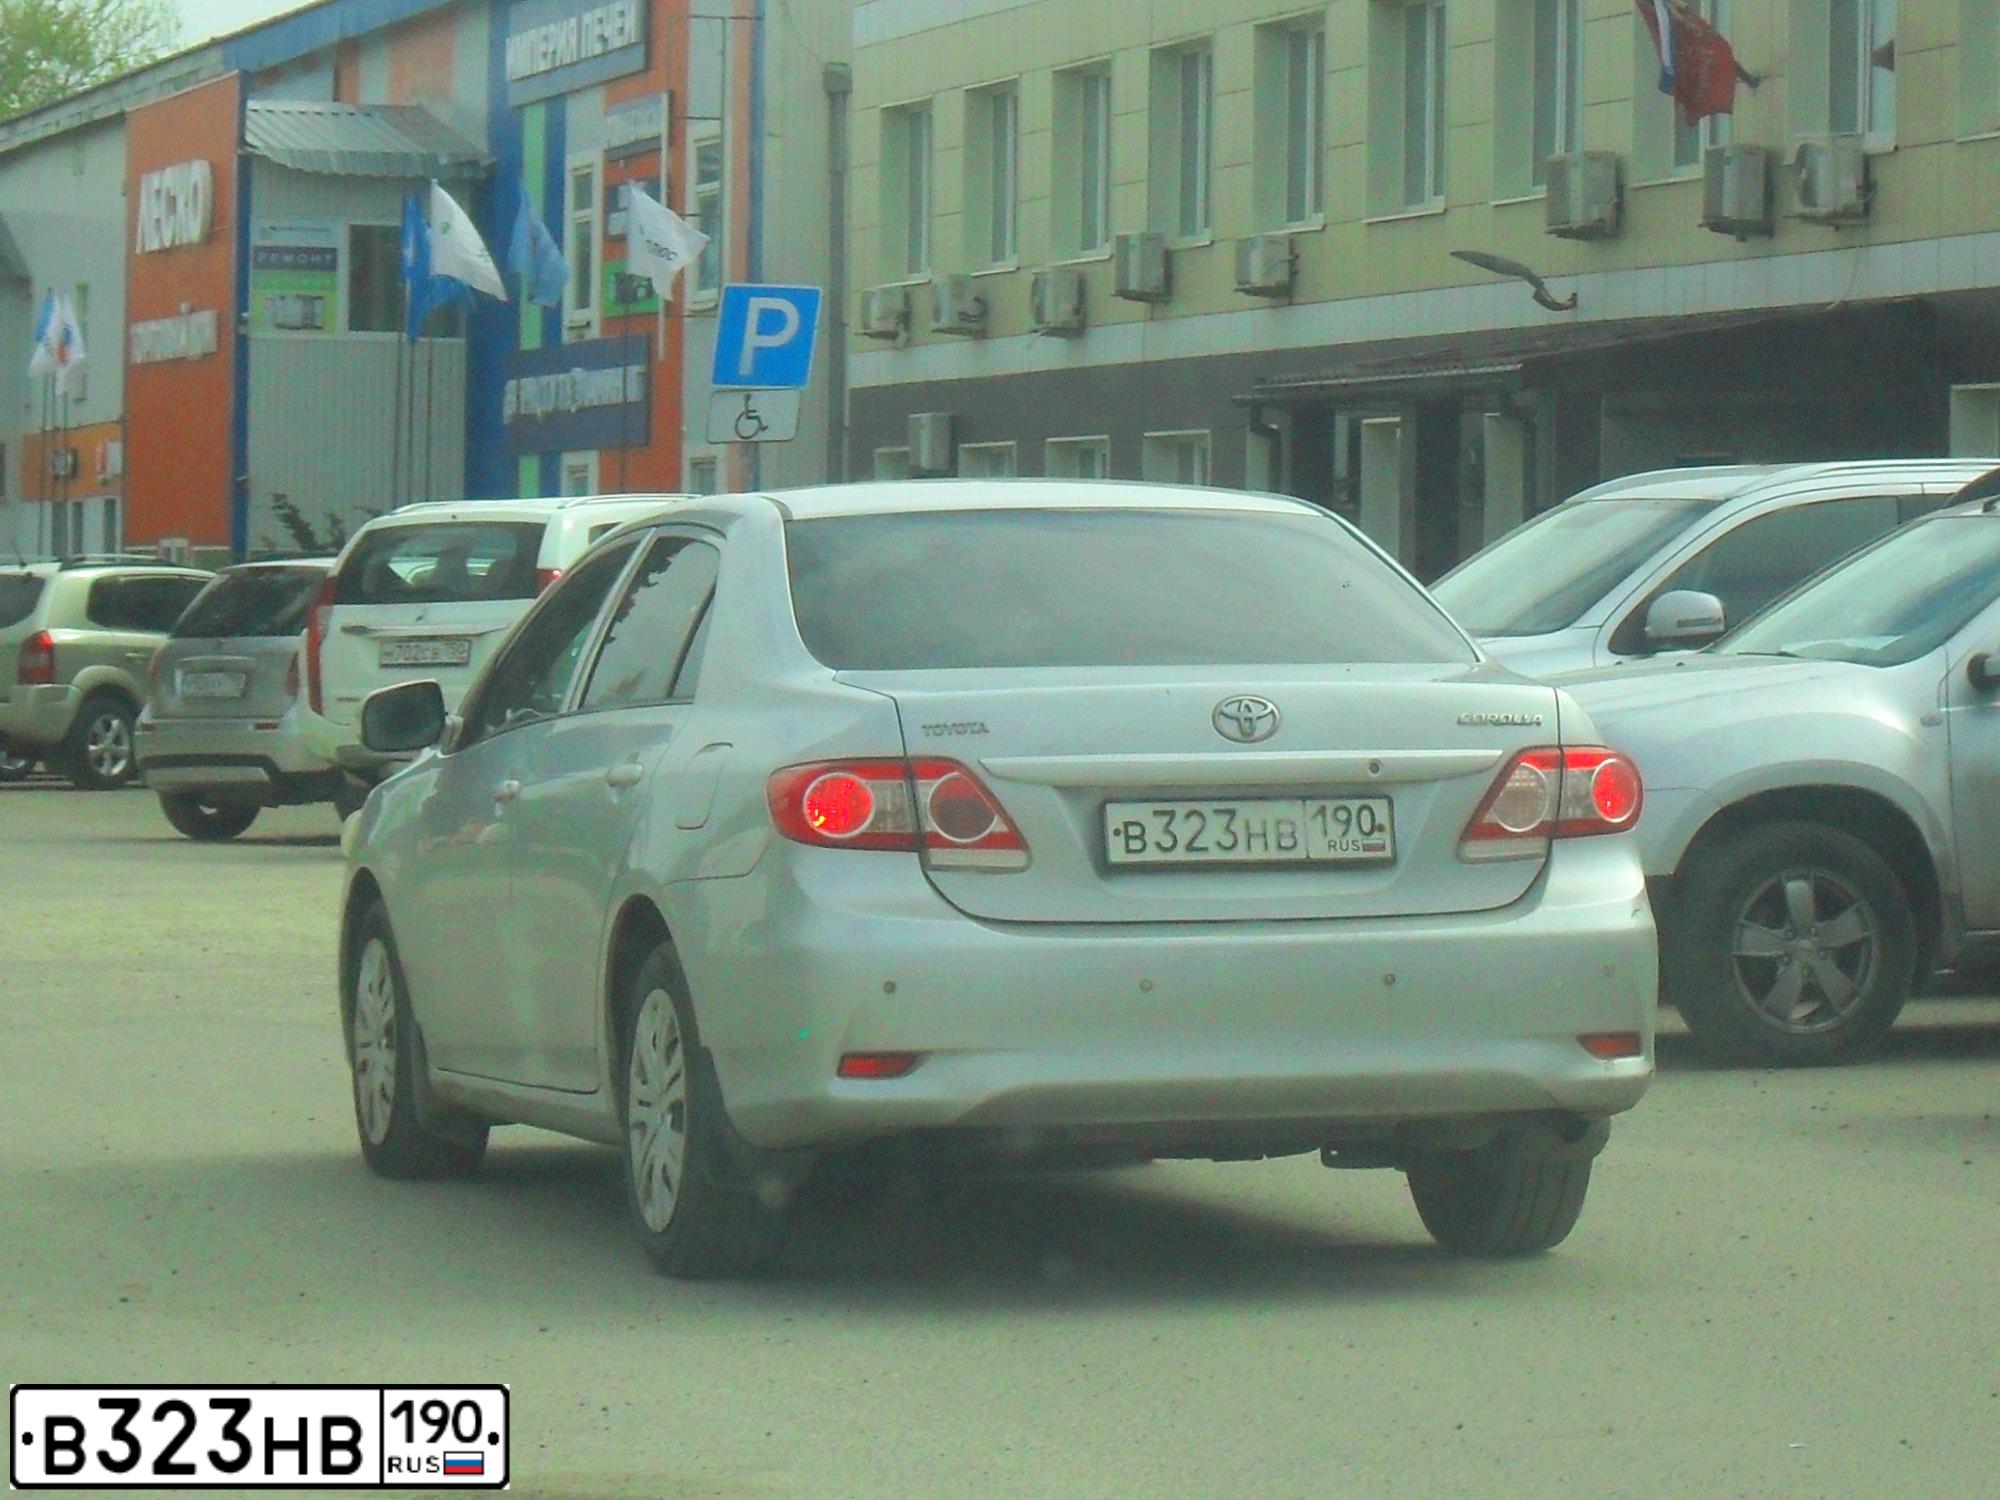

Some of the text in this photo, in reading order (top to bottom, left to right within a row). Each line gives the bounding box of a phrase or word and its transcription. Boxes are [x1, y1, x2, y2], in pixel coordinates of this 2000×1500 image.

[739, 297, 800, 377] P
[1457, 713, 1543, 726] COROLLA
[921, 722, 990, 737] TOYOTA
[1312, 804, 1377, 836] 190
[1327, 839, 1361, 852] RUS
